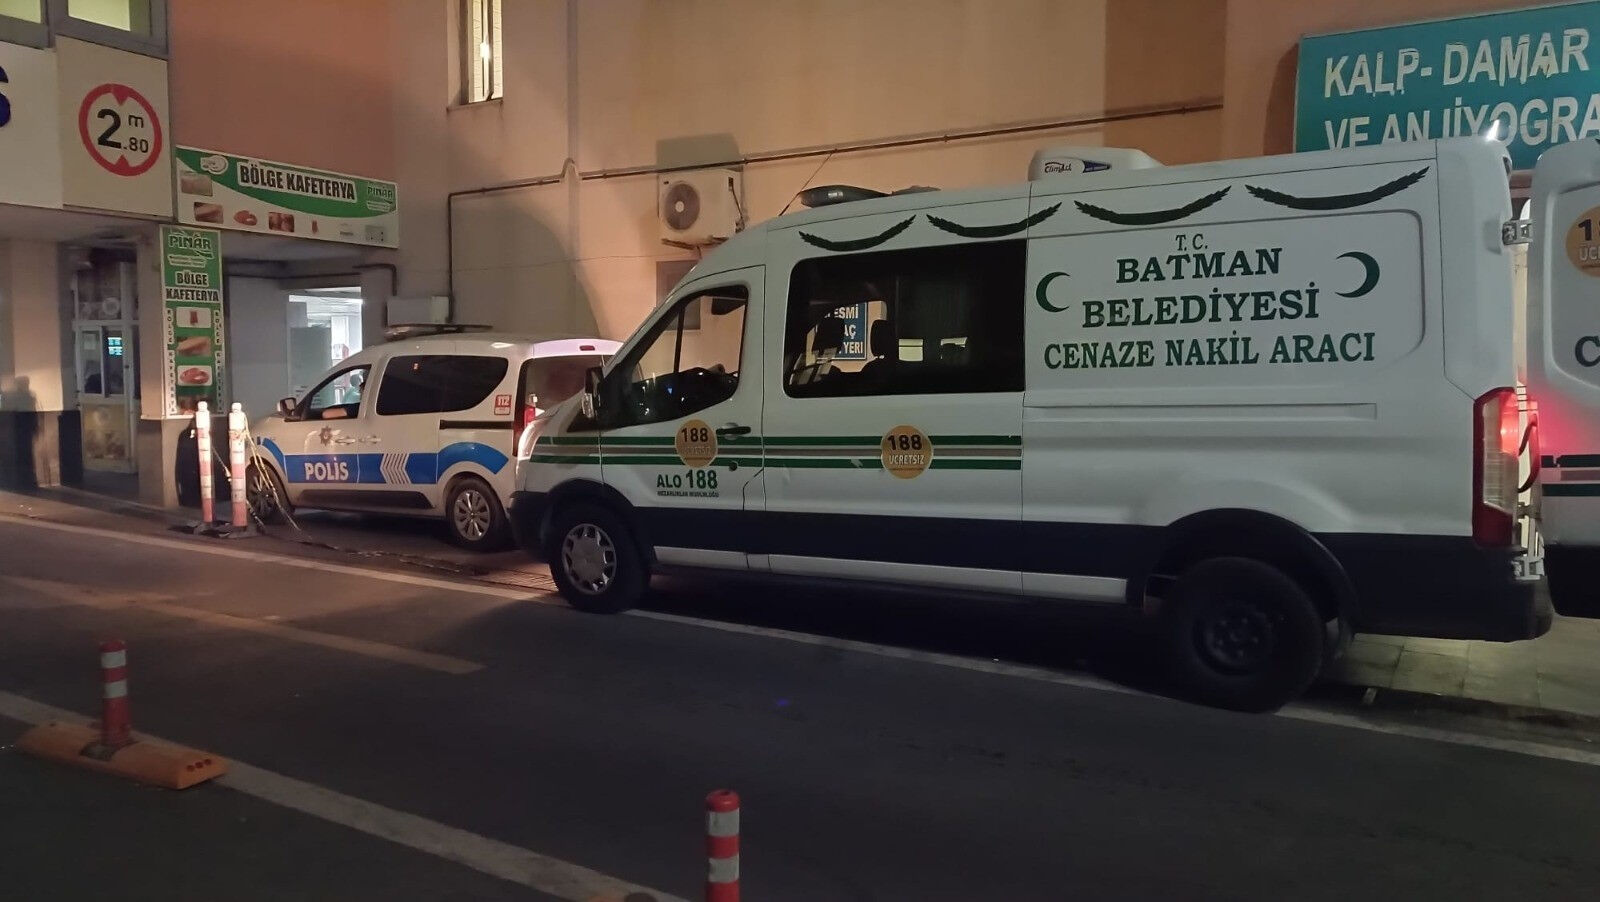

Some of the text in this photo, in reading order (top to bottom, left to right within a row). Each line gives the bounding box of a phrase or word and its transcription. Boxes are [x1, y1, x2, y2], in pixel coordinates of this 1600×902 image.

[1324, 28, 1590, 98] KALP- DAMAR
[97, 108, 144, 150] 2 m
[1324, 116, 1370, 150] VE
[240, 163, 355, 200] BÖLGE KAFETERYA
[1578, 218, 1600, 241] 1
[176, 271, 208, 286] BÖLGE
[1116, 247, 1283, 284] BATMAN
[166, 287, 219, 302] KAFETERYA
[1082, 281, 1320, 328] BELEDİYESİ
[1043, 330, 1376, 370] CENAZE NAKİL ARACI
[681, 427, 708, 443] 188
[887, 434, 923, 451] 188
[304, 456, 349, 481] POLİS
[656, 469, 718, 489] ALO 188
